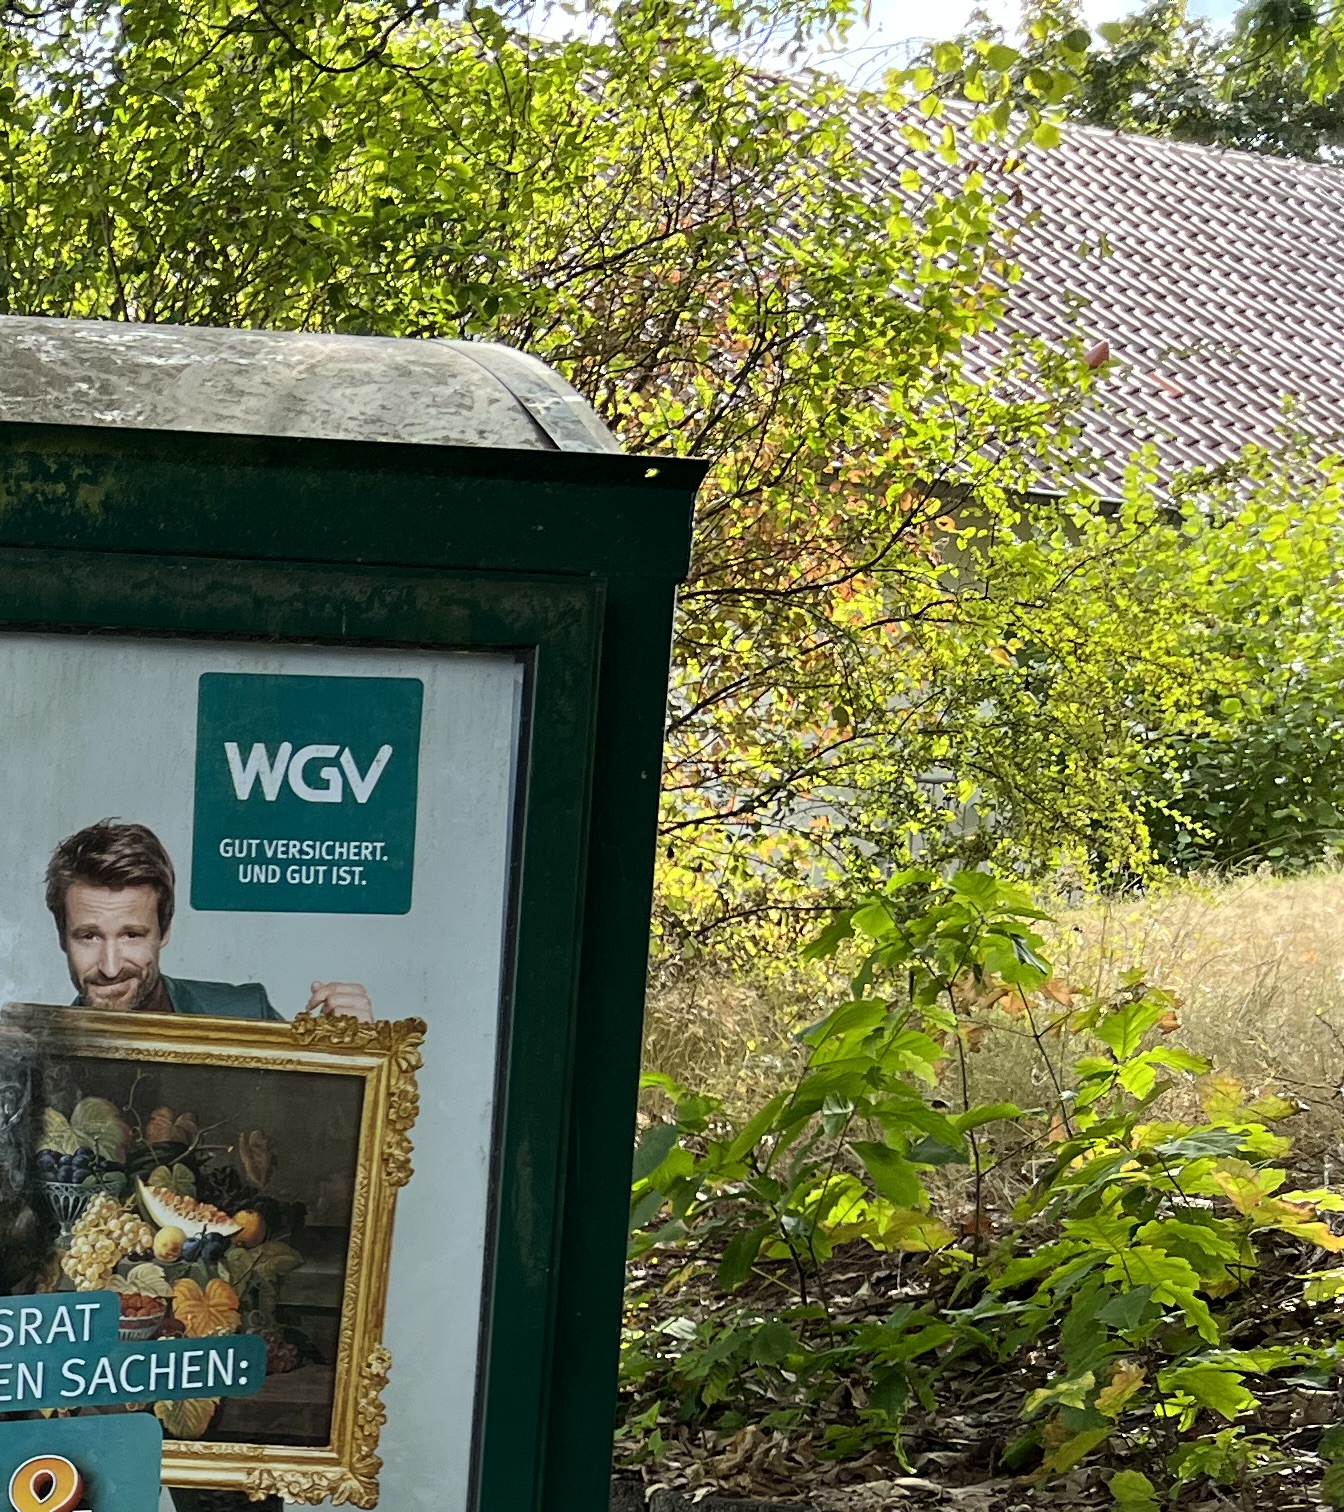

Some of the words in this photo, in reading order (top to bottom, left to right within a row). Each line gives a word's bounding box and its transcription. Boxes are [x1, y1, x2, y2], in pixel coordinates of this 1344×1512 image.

[223, 741, 393, 804] WGV
[219, 839, 261, 858] GUT
[263, 839, 389, 862] VERSICHERT.
[238, 863, 280, 884] UND
[286, 865, 327, 885] GUT
[331, 866, 367, 886] IST.
[60, 1347, 249, 1397] SACHEN:
